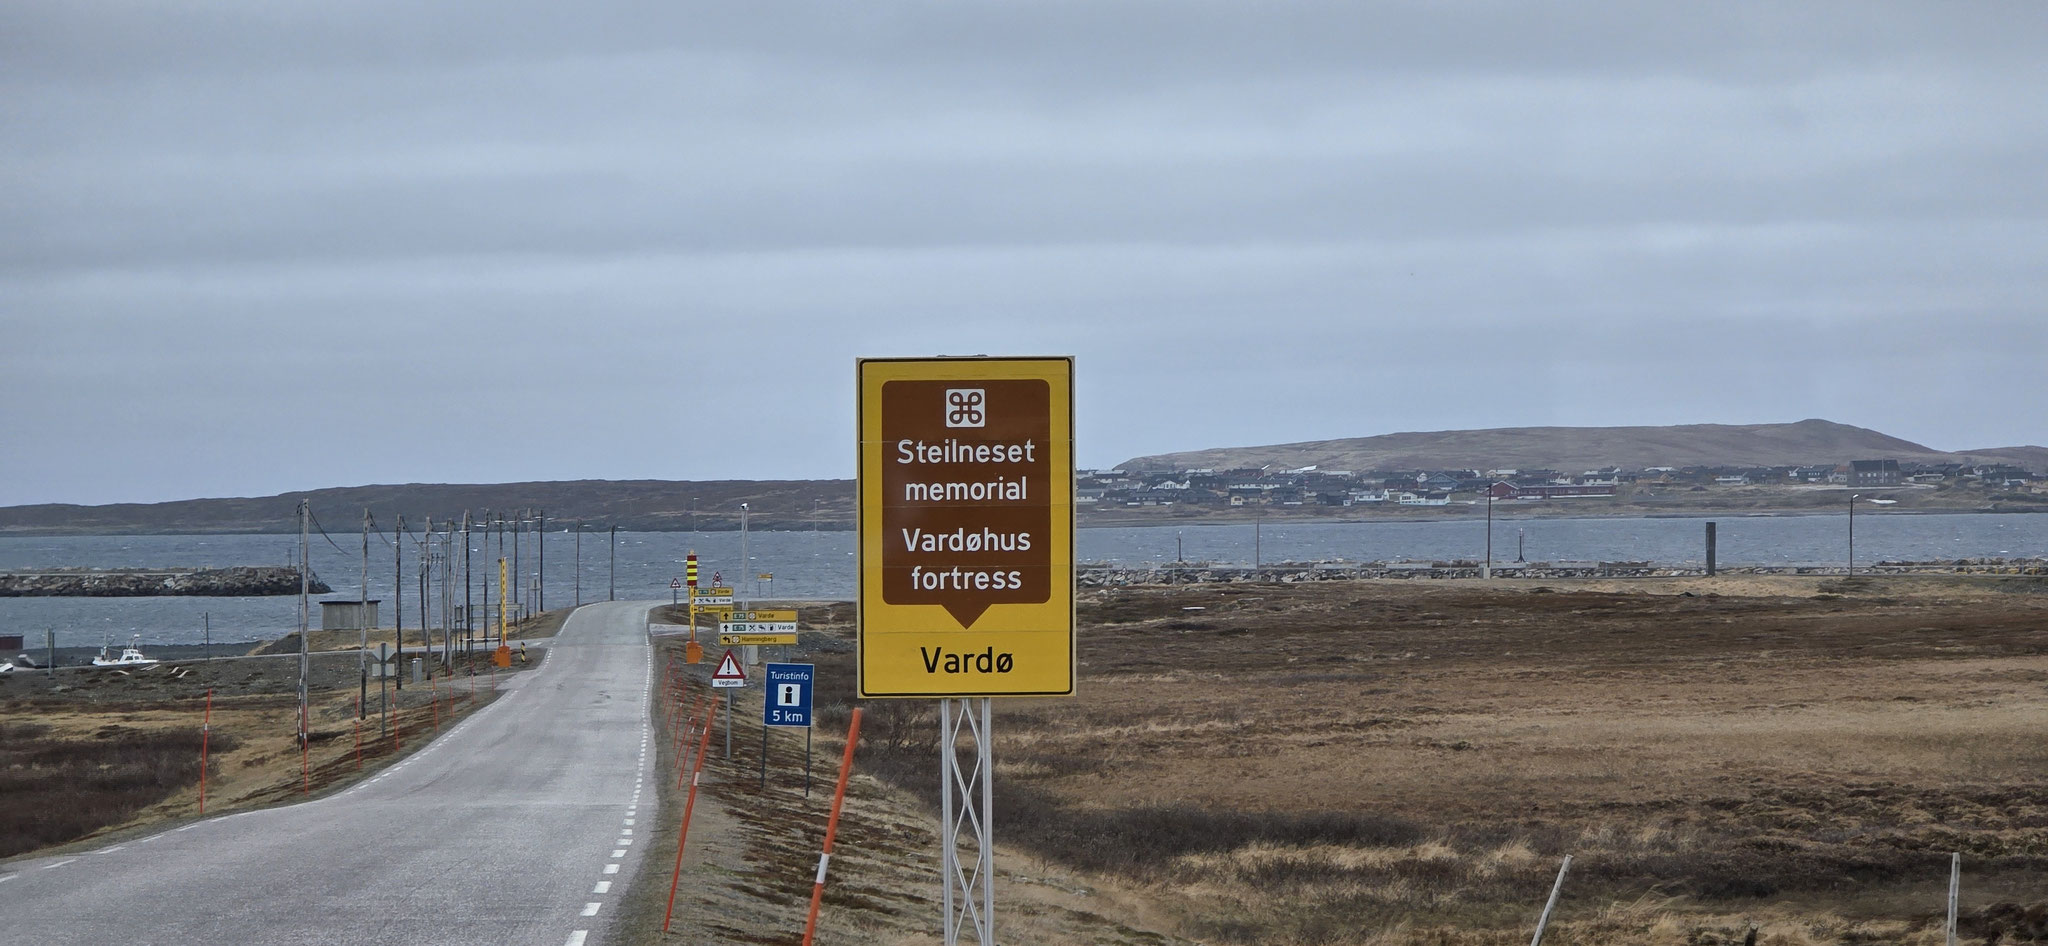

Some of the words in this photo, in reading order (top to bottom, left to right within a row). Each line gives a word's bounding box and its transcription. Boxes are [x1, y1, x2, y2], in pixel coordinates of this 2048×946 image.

[896, 438, 1036, 464] Steilneset
[904, 476, 1027, 501] memorial
[902, 527, 1031, 553] Vardøhus
[911, 565, 1022, 590] fortress
[920, 646, 1014, 674] Vardø
[770, 671, 809, 681] Turistinfo
[772, 710, 781, 722] 5
[785, 710, 803, 722] km
